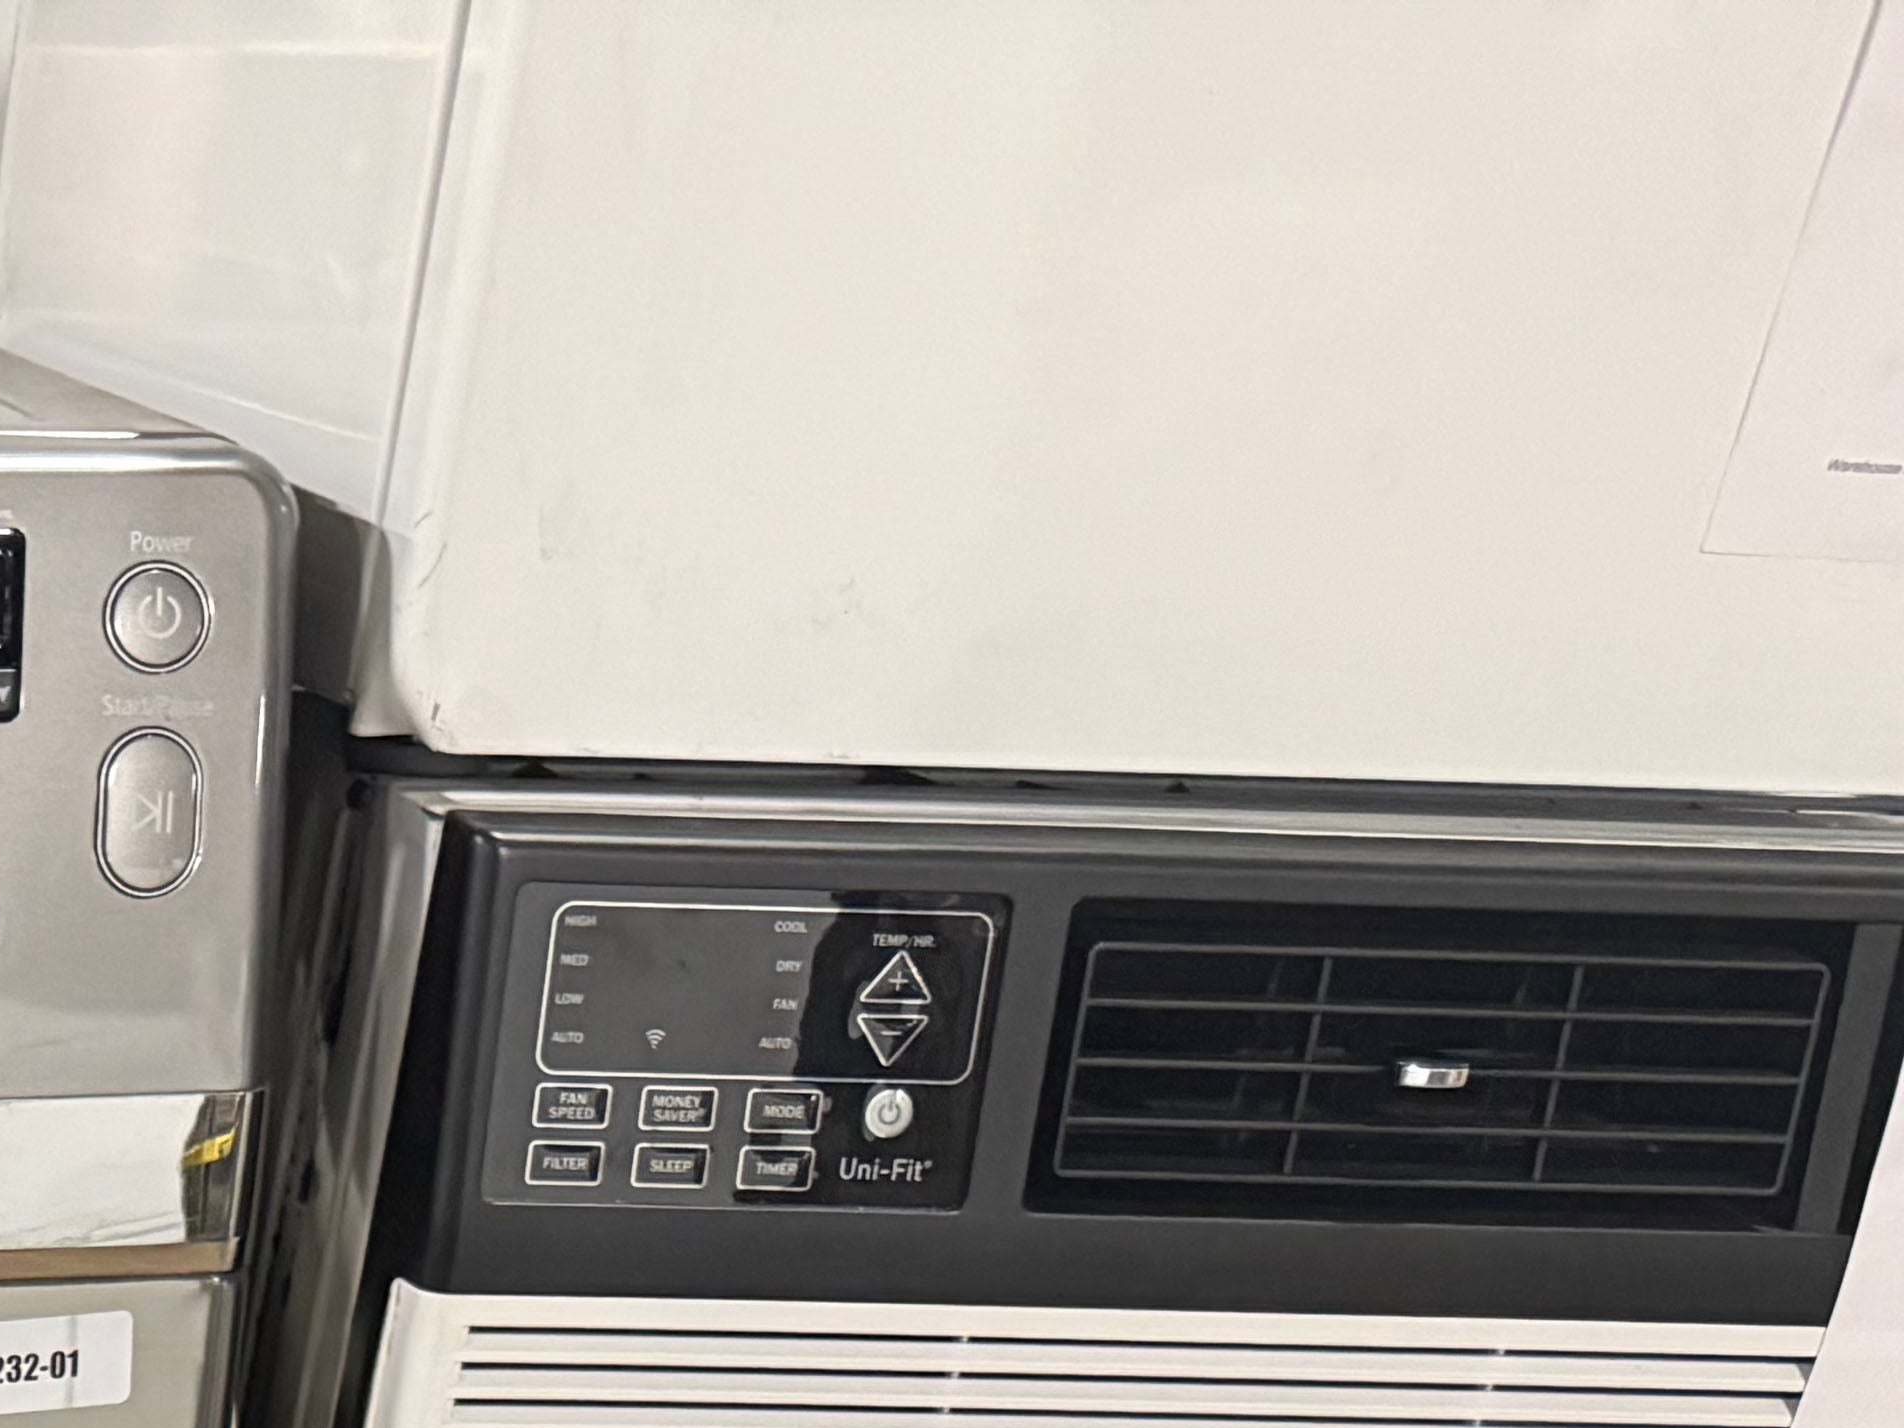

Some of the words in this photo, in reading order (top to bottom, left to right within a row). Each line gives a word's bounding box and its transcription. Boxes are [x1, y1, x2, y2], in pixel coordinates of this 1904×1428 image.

[130, 531, 193, 553] Power
[565, 915, 597, 927] HIGH
[774, 921, 808, 934] COOL
[560, 954, 589, 966] MED
[775, 960, 802, 973] DRY
[554, 993, 584, 1005] LOW
[773, 999, 798, 1011] FAN
[551, 1032, 584, 1044] AUTO
[758, 1037, 793, 1050] AUTO
[559, 1092, 588, 1105] FAN
[652, 1095, 702, 1109] MONEY
[548, 1107, 596, 1120] SPEED
[763, 1104, 805, 1119] MODE
[543, 1156, 589, 1171] FILTER
[649, 1159, 694, 1173] SLEEP
[756, 1162, 798, 1177] TIMER
